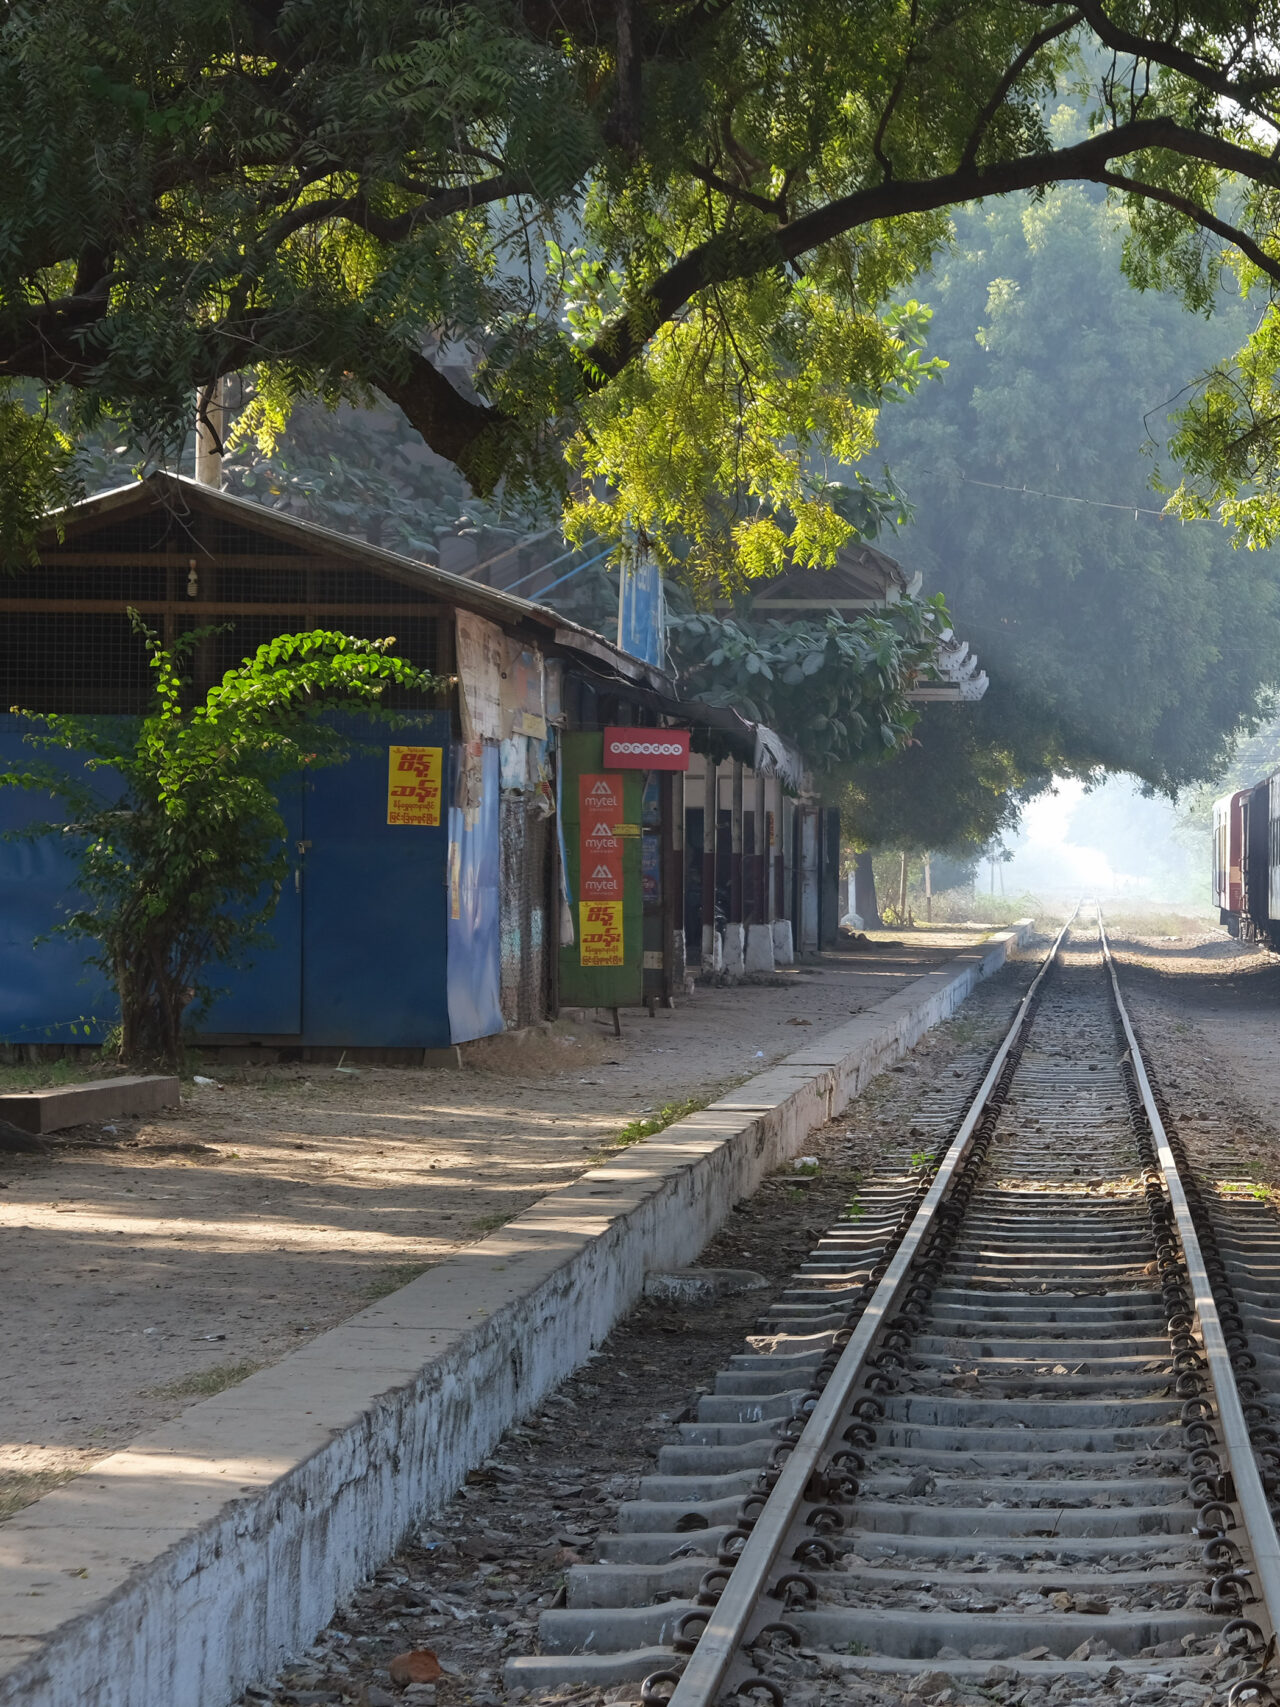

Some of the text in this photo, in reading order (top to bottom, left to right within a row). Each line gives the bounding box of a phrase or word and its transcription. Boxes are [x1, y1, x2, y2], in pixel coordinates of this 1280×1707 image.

[610, 742, 683, 756] ooredoo
[585, 796, 618, 808] mytel
[585, 837, 618, 850] mytel
[585, 879, 618, 891] mytel
